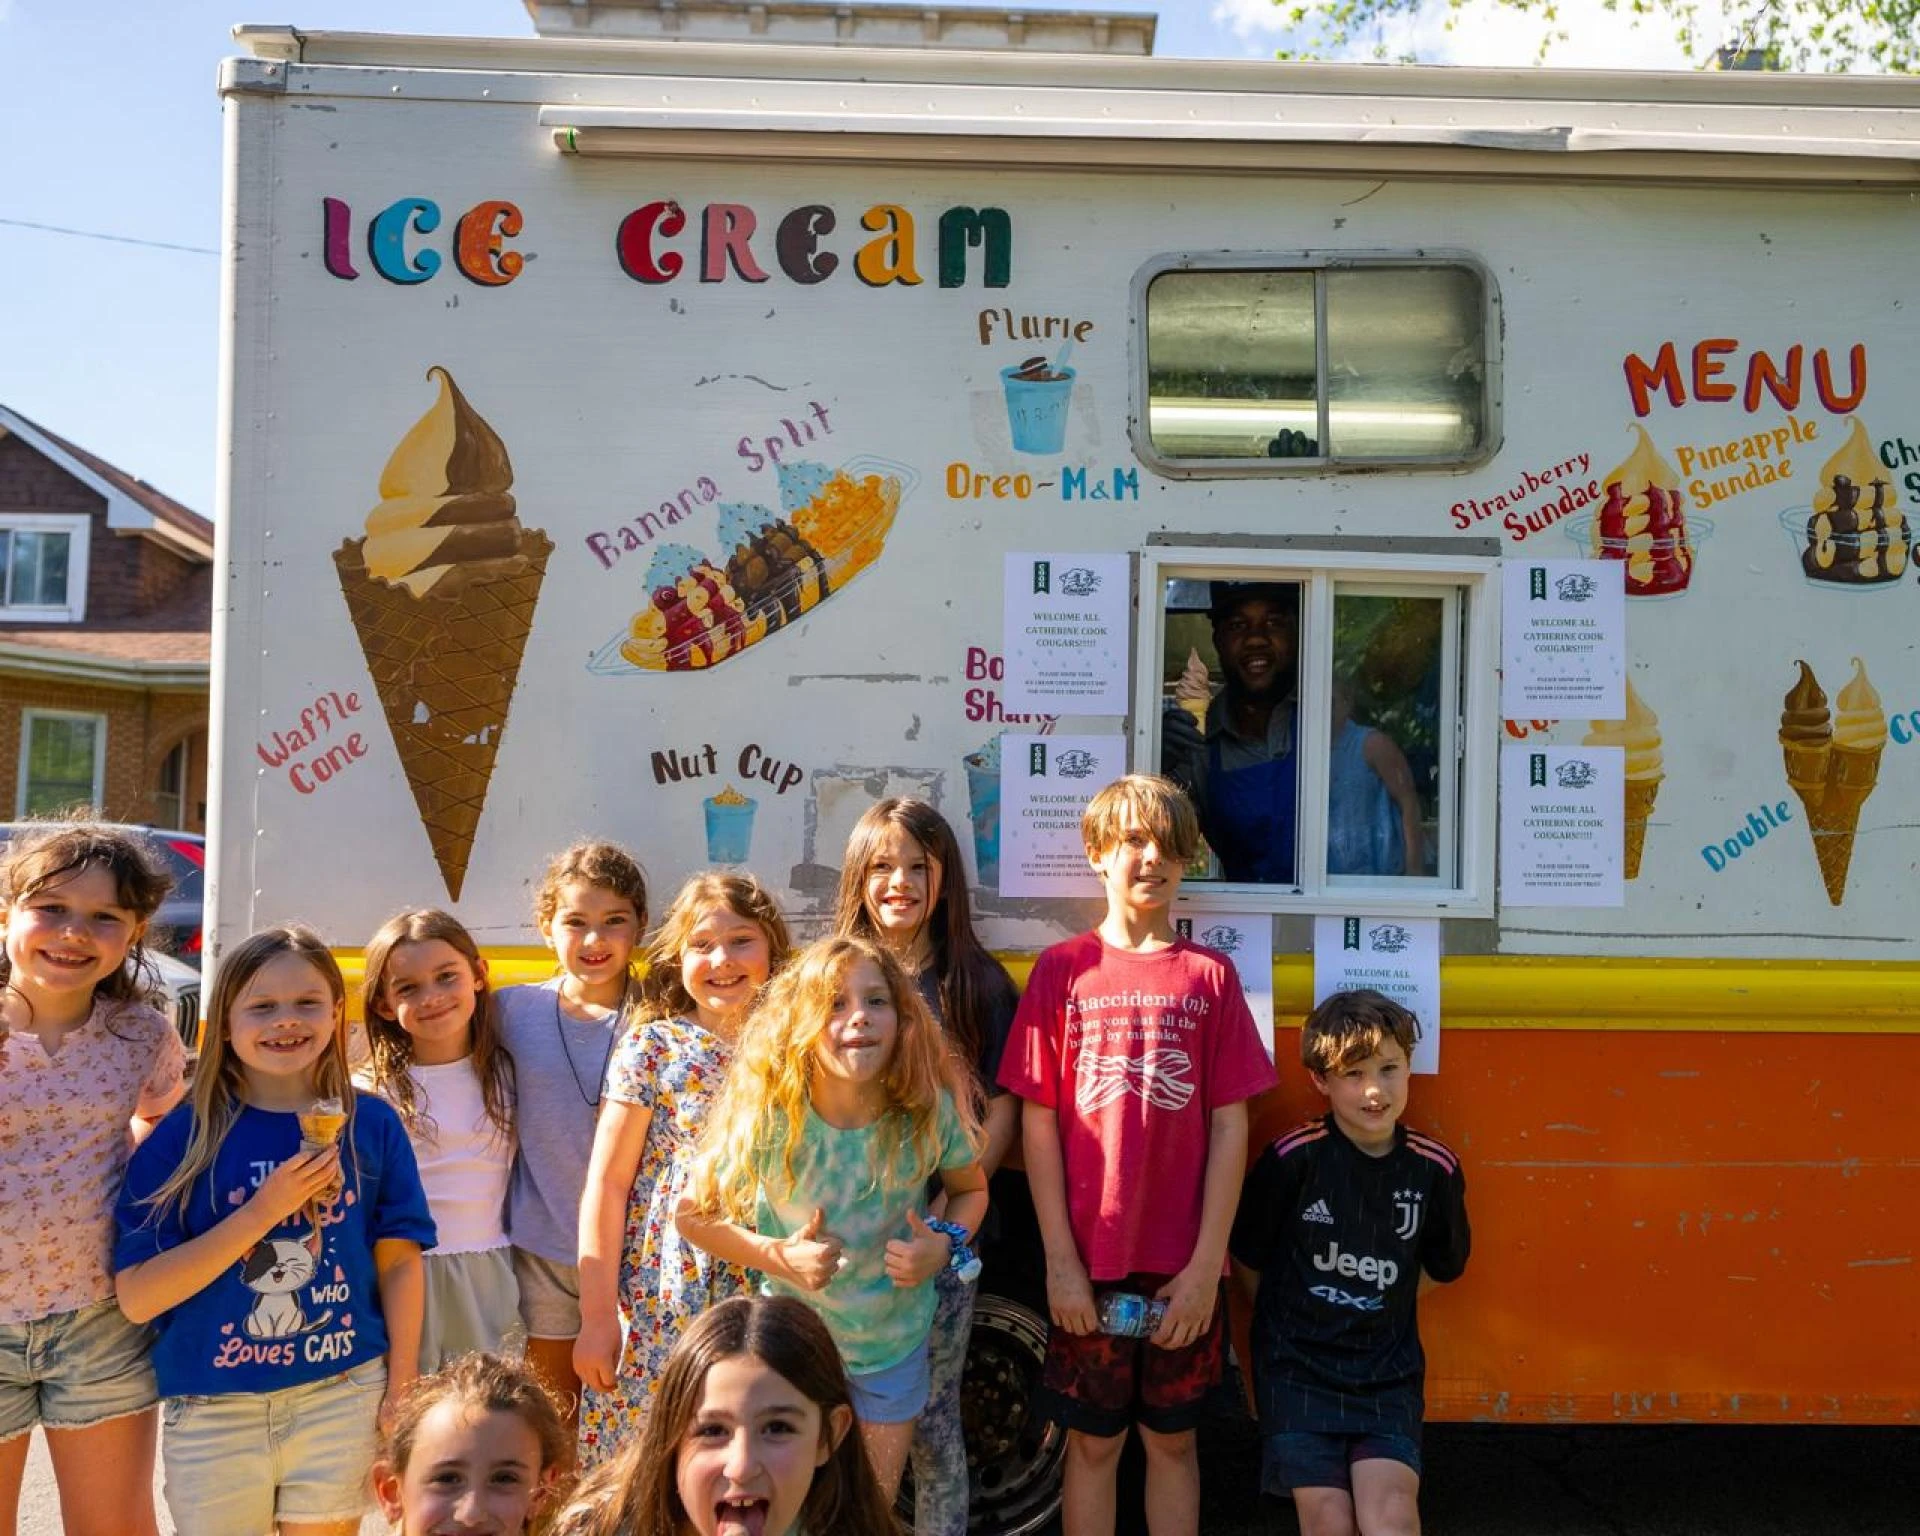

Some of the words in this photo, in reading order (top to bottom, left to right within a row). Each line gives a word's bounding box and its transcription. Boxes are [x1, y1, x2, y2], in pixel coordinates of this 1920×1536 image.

[323, 197, 523, 287] ICE
[1623, 338, 1867, 417] MENU
[1675, 414, 1820, 477] Pineapple
[585, 476, 722, 571] Banana
[737, 401, 834, 473] Split
[1450, 452, 1590, 530] Strawberry
[1688, 458, 1795, 509] Sundae
[1503, 479, 1601, 541] Sundae
[1033, 613, 1080, 622] WELCOME
[1083, 613, 1102, 622] ALL
[1523, 632, 1577, 641] CATHERINE
[257, 691, 362, 768] Waffle
[289, 732, 369, 794] Cone
[651, 743, 718, 785] Nut
[738, 743, 803, 794] Cup
[1530, 805, 1577, 814] WELCOME
[1579, 805, 1597, 814] ALL
[1577, 819, 1605, 828] COOK
[1701, 800, 1793, 873] Double
[1344, 968, 1391, 978] WELCOME
[1178, 1016, 1197, 1030] the
[1313, 1241, 1399, 1290] Jeep
[311, 1283, 349, 1305] WHO
[213, 1337, 296, 1368] Loves
[304, 1329, 356, 1362] CATS
